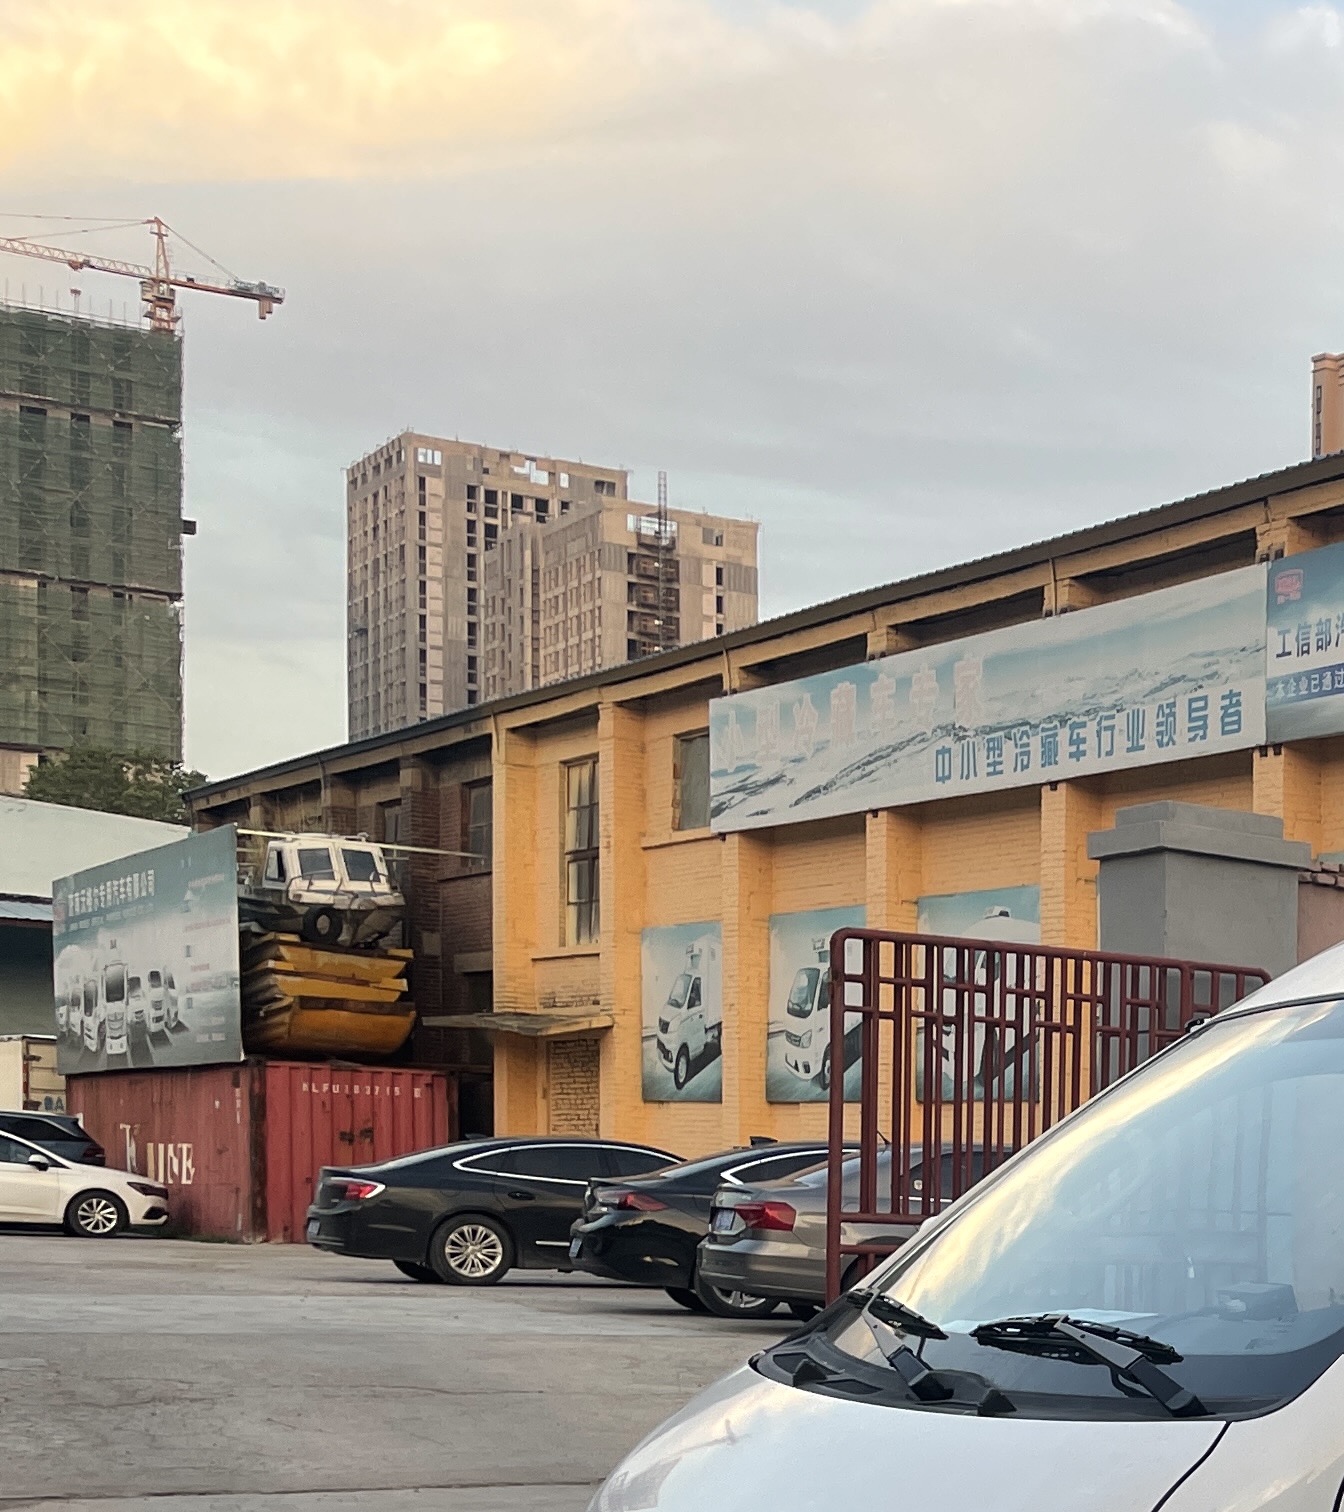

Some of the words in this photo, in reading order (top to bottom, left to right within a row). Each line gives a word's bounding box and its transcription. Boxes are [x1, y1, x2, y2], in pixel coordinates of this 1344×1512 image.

[934, 688, 1244, 784] 中小型冷藏车行业领导者
